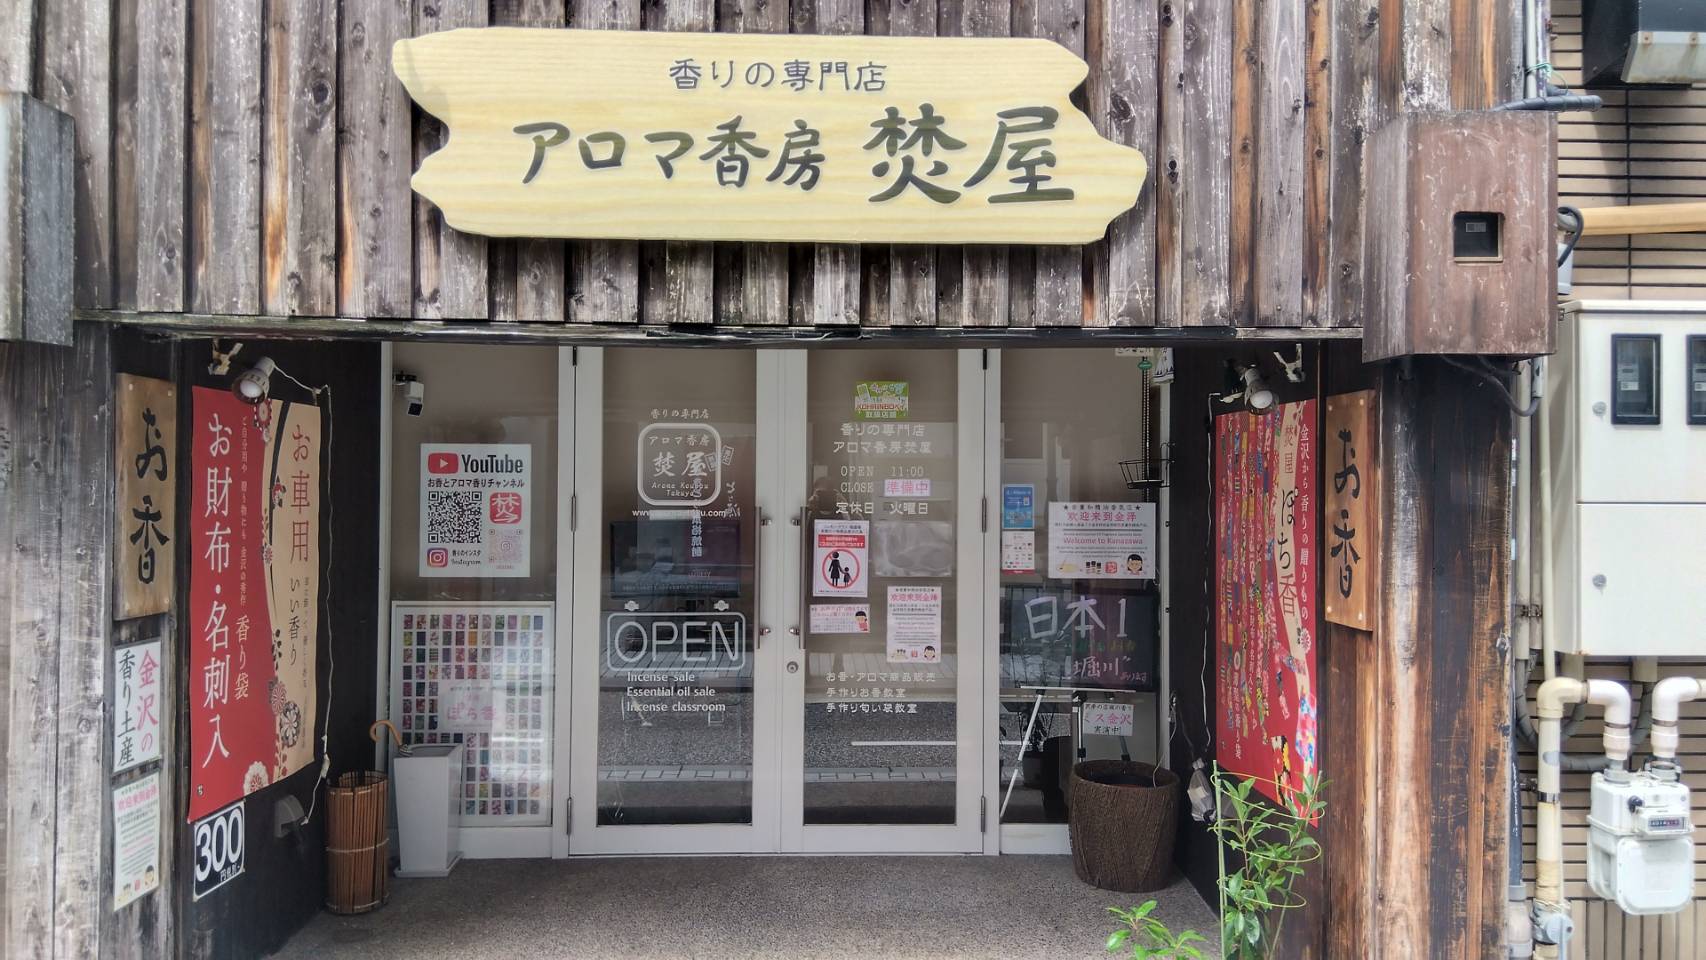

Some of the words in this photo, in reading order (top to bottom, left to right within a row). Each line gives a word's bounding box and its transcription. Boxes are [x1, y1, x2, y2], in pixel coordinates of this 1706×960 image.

[669, 58, 888, 93] 香りの専門店
[513, 115, 826, 192] アロマ香房
[862, 102, 1075, 205] 焚屋
[651, 408, 711, 420] 香りの専門店
[840, 423, 926, 437] 香りの専門店
[648, 435, 711, 447] アロマ香房
[833, 441, 932, 454] アロマ香房焚屋
[461, 454, 524, 473] YouTube
[653, 451, 708, 478] 焚屋
[840, 465, 875, 477] OPEN
[891, 465, 924, 477] 11:00
[427, 478, 525, 488] お香とアロマ香りチャンネル
[840, 482, 874, 493] CLOSE
[886, 480, 928, 495] 準備中
[130, 407, 170, 586] お香
[290, 424, 311, 563] お車用
[835, 501, 875, 515] 定休日
[889, 501, 929, 515] 火曜日
[1330, 428, 1361, 600] お香
[1063, 537, 1097, 545] Welcome
[1097, 537, 1106, 545] to
[1107, 537, 1143, 545] Kanazawa
[1279, 488, 1298, 616] ぽち香
[202, 413, 233, 769] お財布・名刺入
[289, 577, 300, 666] いい香り
[615, 621, 739, 663] OPEN
[235, 615, 250, 701] 香り袋
[627, 672, 668, 682] Incense
[673, 672, 695, 682] sale
[826, 671, 936, 682] お香・アロマ商品販売
[135, 648, 160, 752] 金沢の
[627, 686, 674, 697] Essential
[677, 686, 691, 697] oil
[694, 686, 716, 697] sale
[826, 687, 907, 698] 手作りお香教室
[117, 648, 136, 768] 香り土産
[627, 702, 668, 712] Incense
[672, 702, 726, 712] classroom
[826, 702, 918, 714] 手作り匂い袋教室
[196, 808, 243, 882] 300
